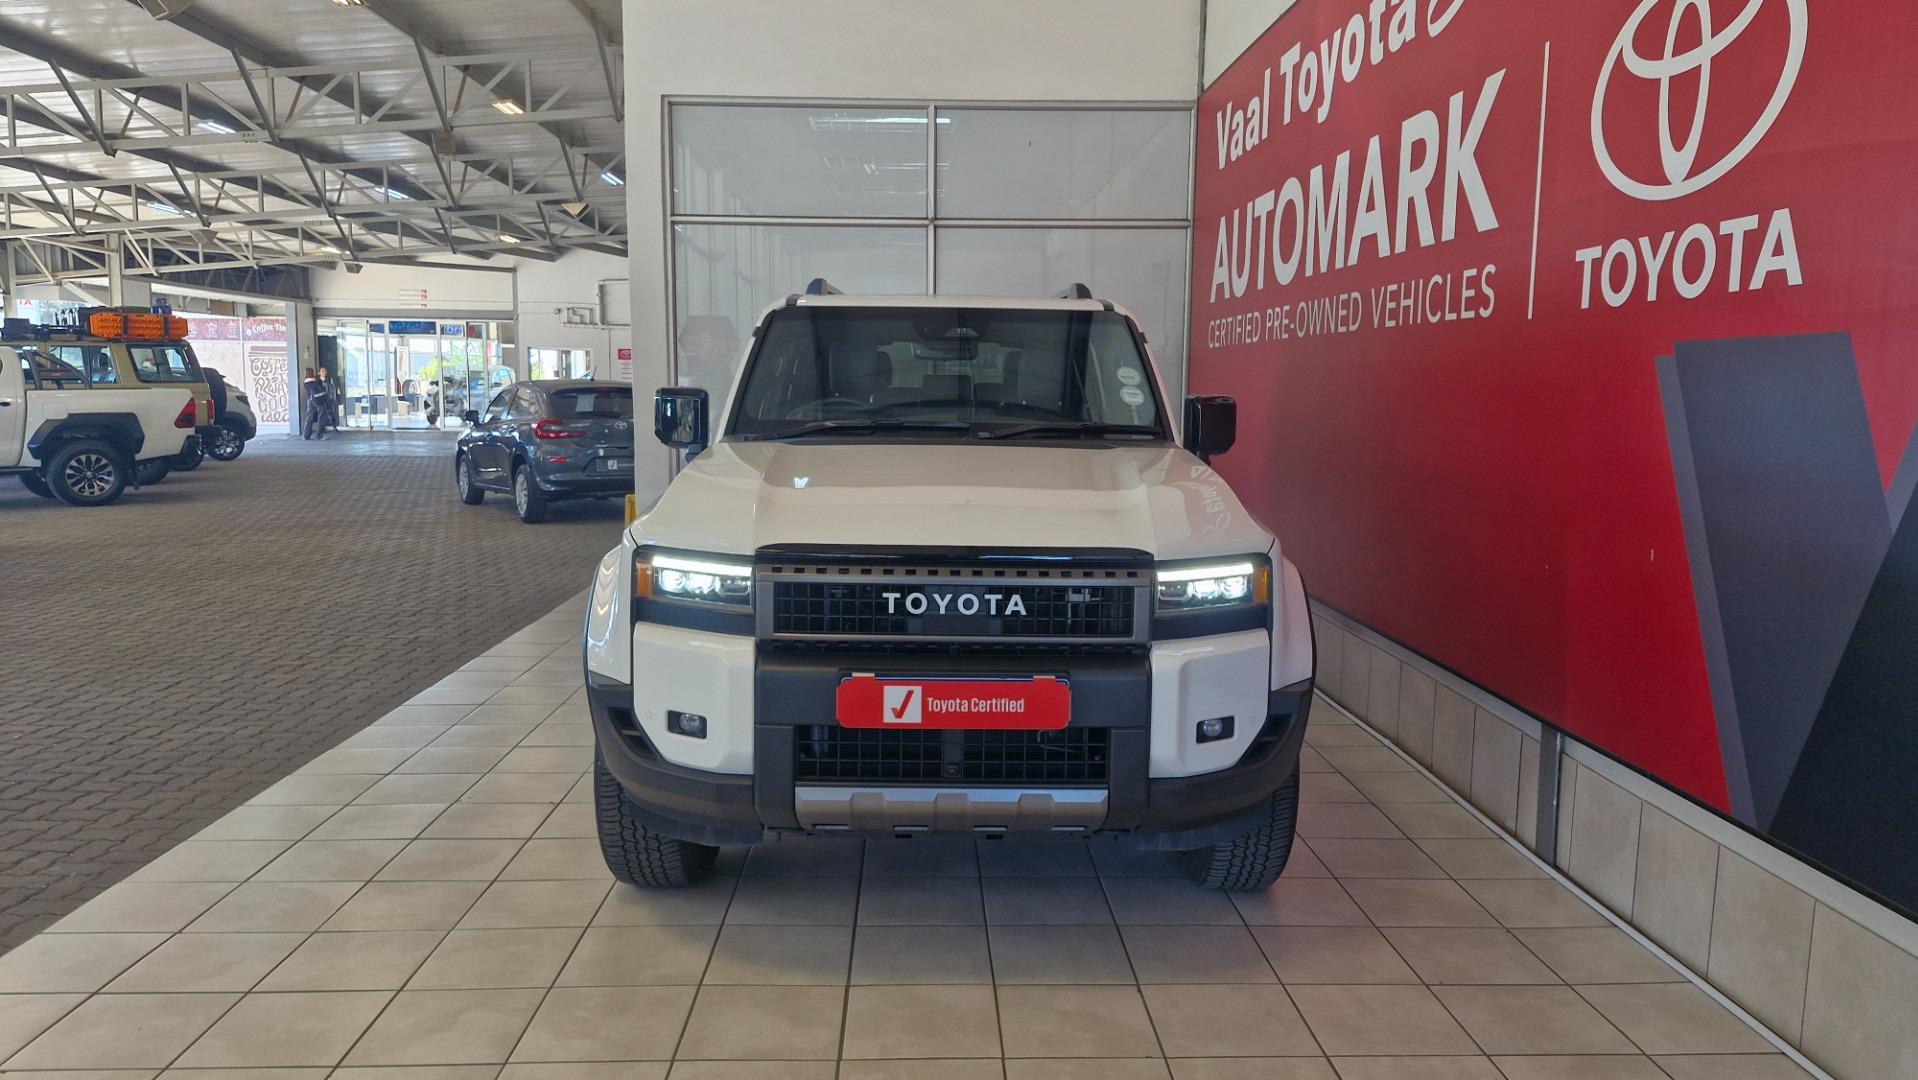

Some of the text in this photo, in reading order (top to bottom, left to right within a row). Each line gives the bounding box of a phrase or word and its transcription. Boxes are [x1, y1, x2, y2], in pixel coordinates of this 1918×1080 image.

[1216, 0, 1417, 170] Vaal Toyota
[1209, 68, 1506, 304] AUTOMARK
[1575, 208, 1803, 310] TOYOTA
[1208, 264, 1496, 349] CERTIFIED PRE-OWNED VEHICLES
[882, 593, 1027, 616] TOYOTA
[927, 698, 1025, 714] Toyota Certified
